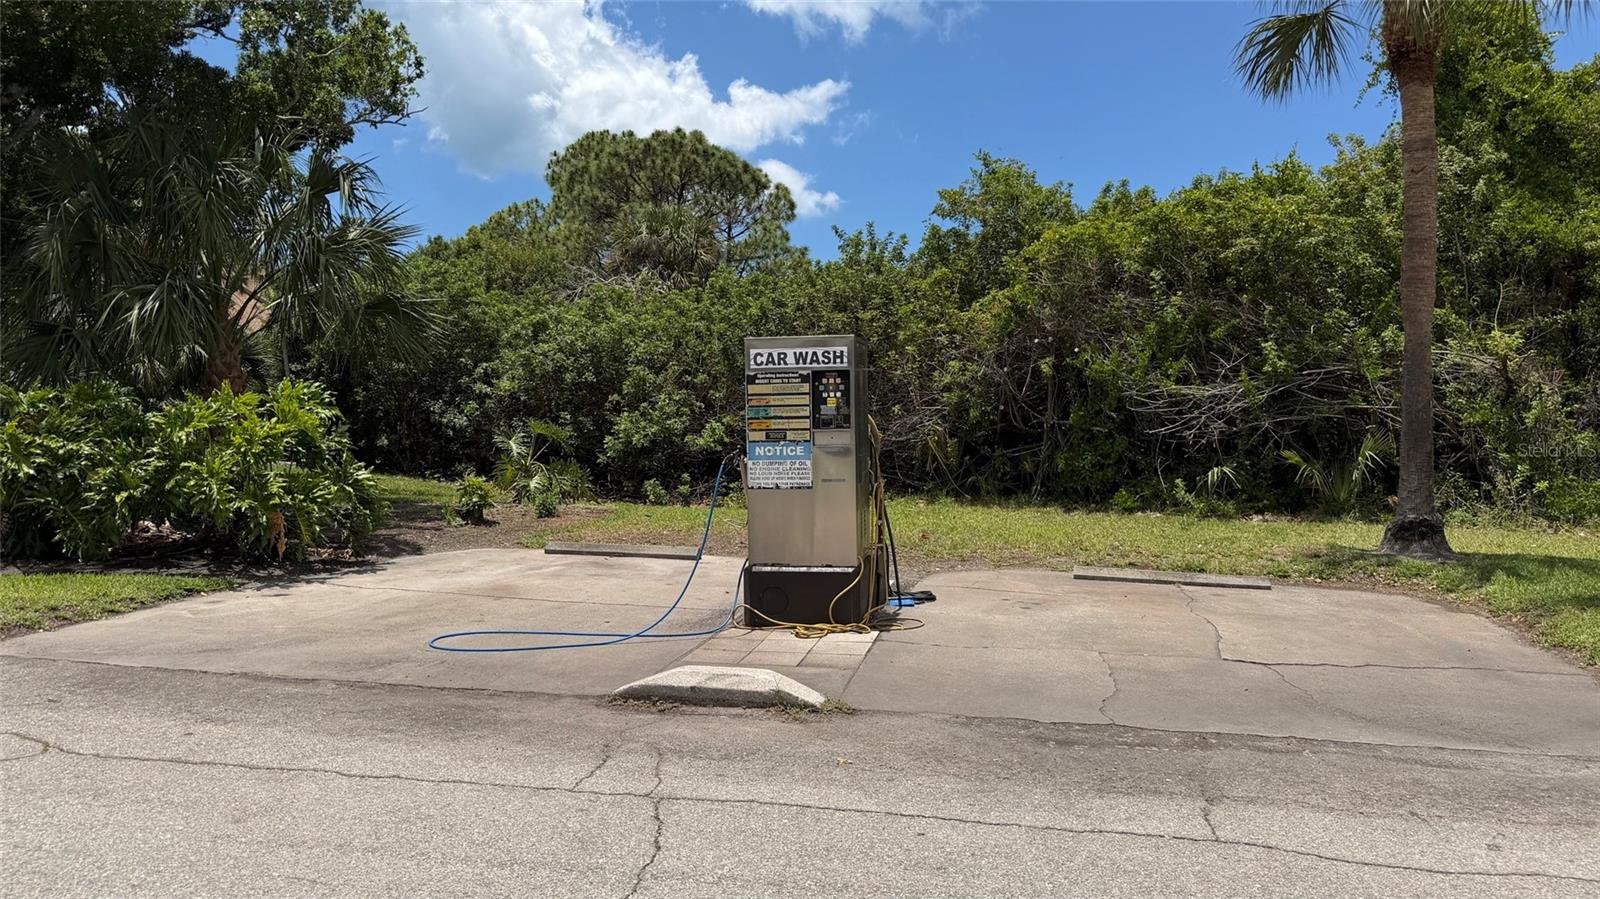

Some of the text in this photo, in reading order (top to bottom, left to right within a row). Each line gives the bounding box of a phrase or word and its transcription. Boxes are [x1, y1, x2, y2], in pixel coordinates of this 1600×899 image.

[753, 350, 844, 366] CAR WASH
[756, 446, 804, 456] NOTICE
